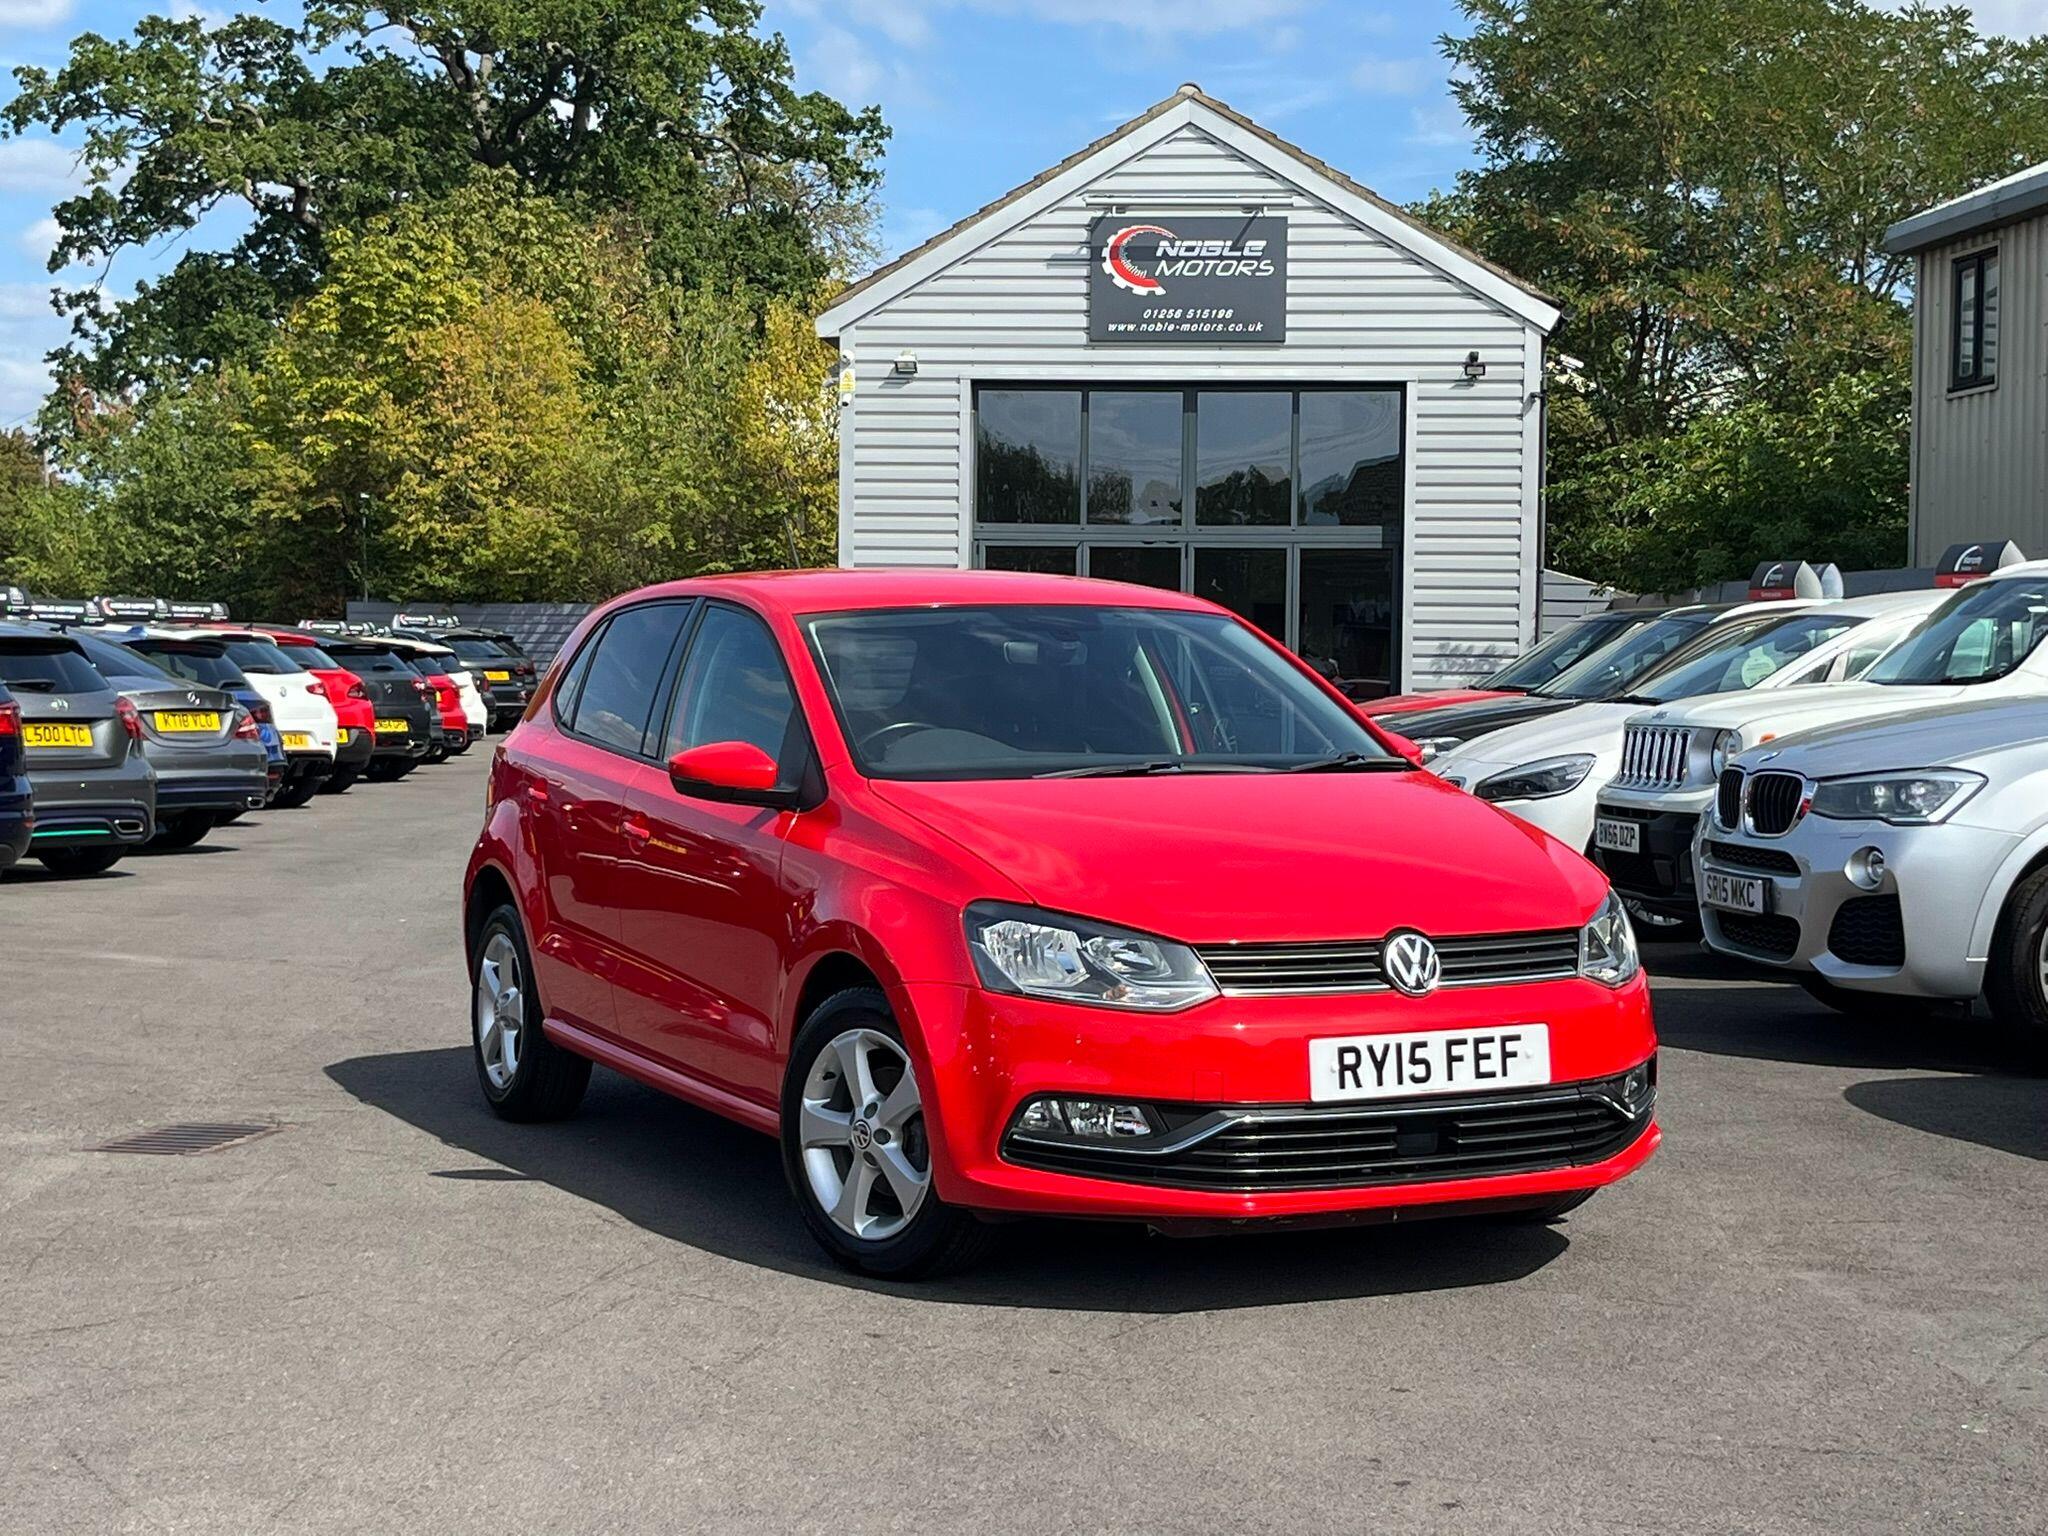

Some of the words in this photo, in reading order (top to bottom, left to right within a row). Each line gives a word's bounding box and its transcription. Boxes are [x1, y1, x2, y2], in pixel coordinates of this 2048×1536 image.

[1155, 240, 1267, 257] NOBLE
[1155, 259, 1275, 277] MOTORS
[1143, 308, 1182, 319] 01256
[1186, 308, 1233, 319] 515196
[1107, 321, 1263, 332] www.noble-motors.co.uk
[24, 725, 60, 742] L500
[1619, 824, 1636, 848] DZP
[1707, 874, 1728, 903] SR15
[1730, 877, 1755, 908] MKC
[1337, 1040, 1432, 1090] RY15
[1445, 1033, 1522, 1082] FEF
